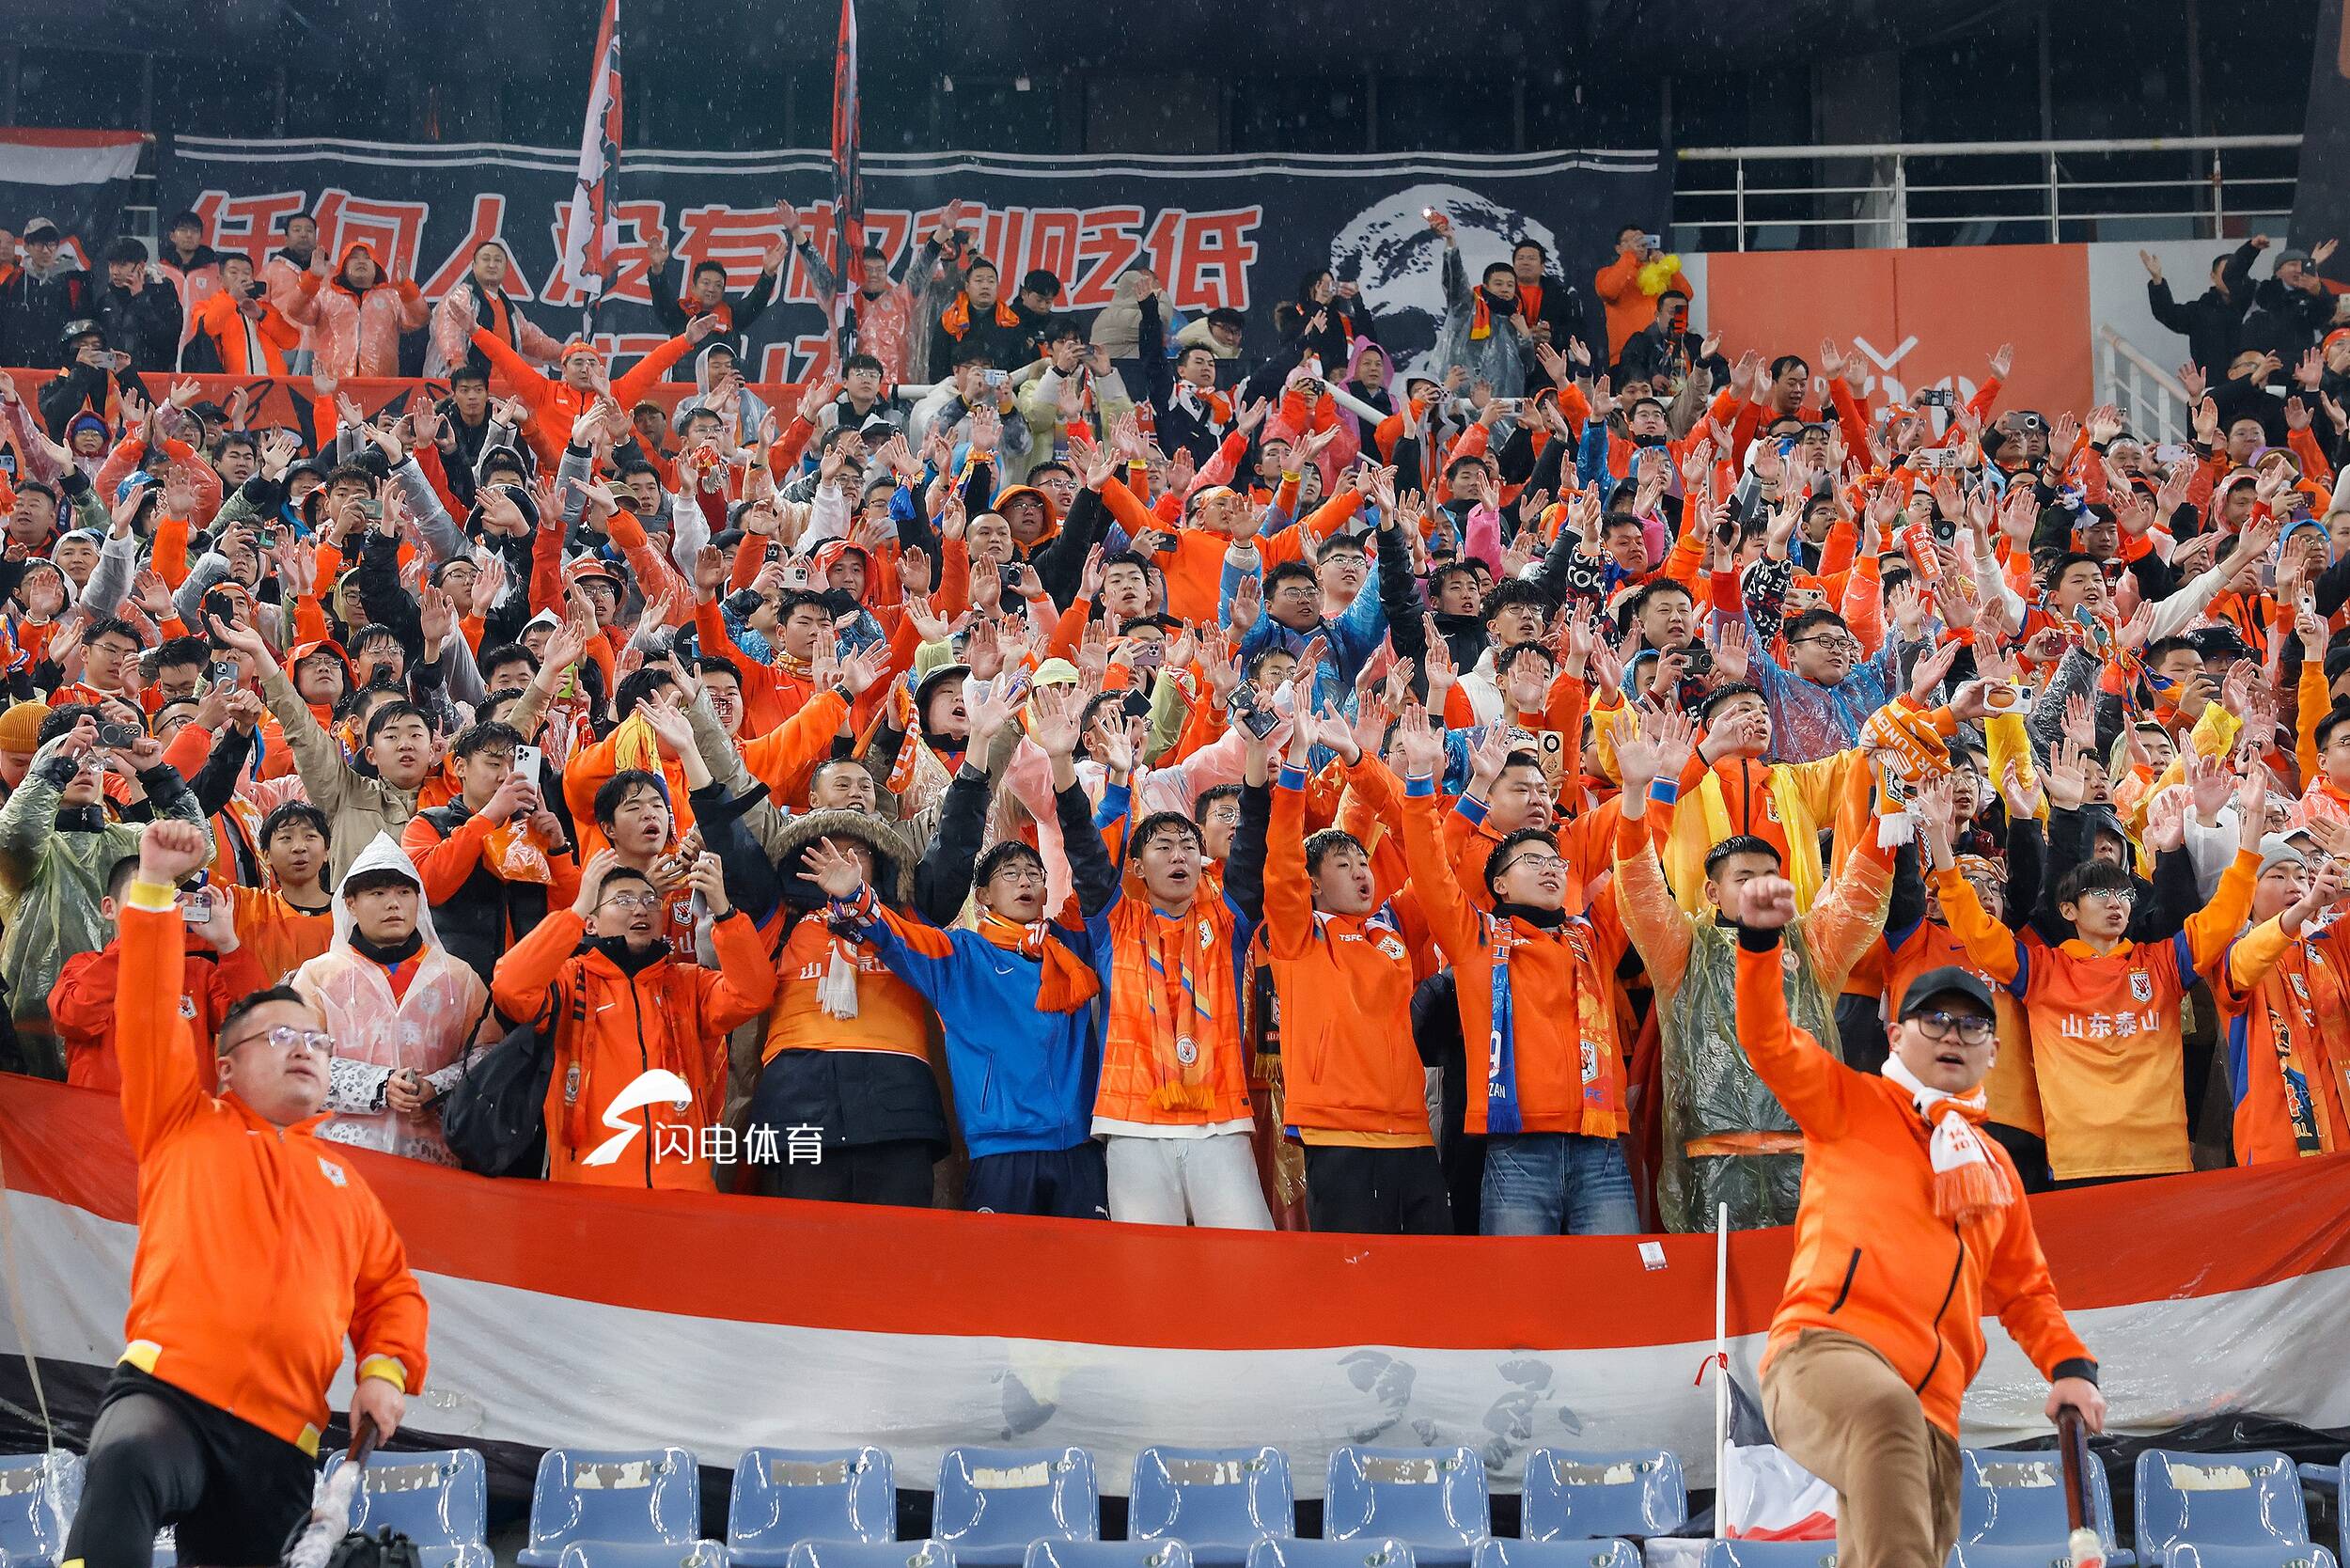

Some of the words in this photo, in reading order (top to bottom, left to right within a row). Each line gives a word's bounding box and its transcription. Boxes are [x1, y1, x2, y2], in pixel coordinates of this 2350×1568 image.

[1339, 933, 1365, 943] TSFC
[2060, 1009, 2160, 1039] 山东泰山
